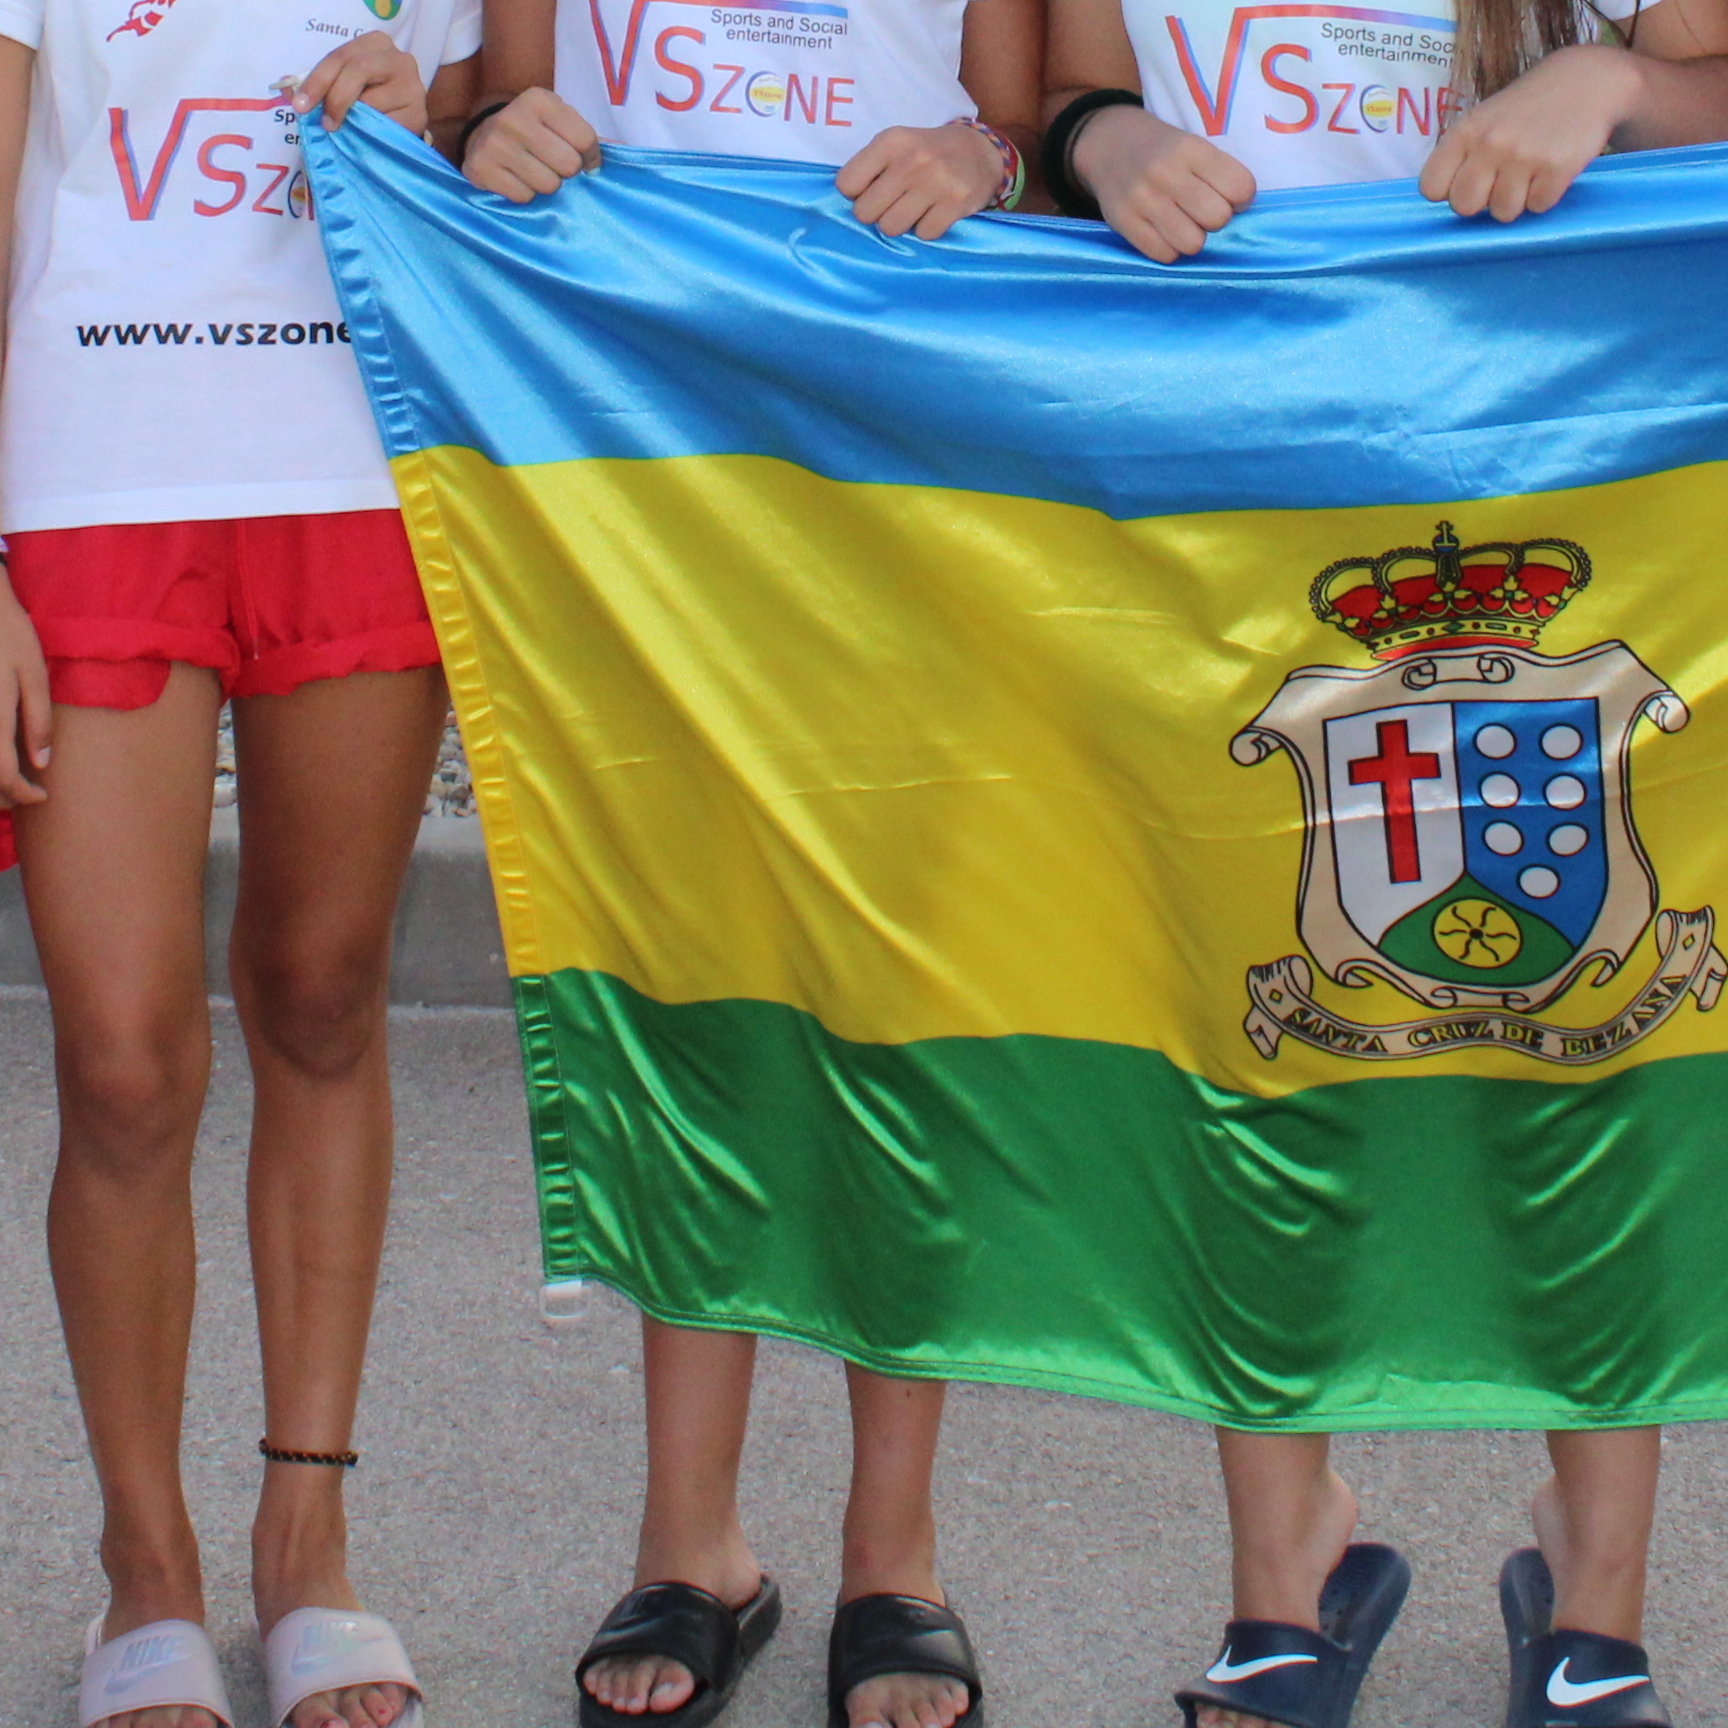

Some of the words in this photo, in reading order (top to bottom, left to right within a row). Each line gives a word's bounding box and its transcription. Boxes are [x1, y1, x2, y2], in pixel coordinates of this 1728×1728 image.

[305, 17, 349, 37] Santa
[710, 8, 763, 32] Sports
[767, 13, 795, 31] and
[798, 16, 849, 35] Social
[1320, 22, 1376, 47] Sports
[1381, 32, 1414, 47] and
[725, 26, 833, 50] entertainment
[76, 320, 352, 347] www.vszone
[1285, 1007, 1388, 1053] SANTA
[1407, 1019, 1494, 1048] CRUZ
[1501, 1021, 1543, 1047] DE
[1560, 973, 1690, 1057] BEZANA
